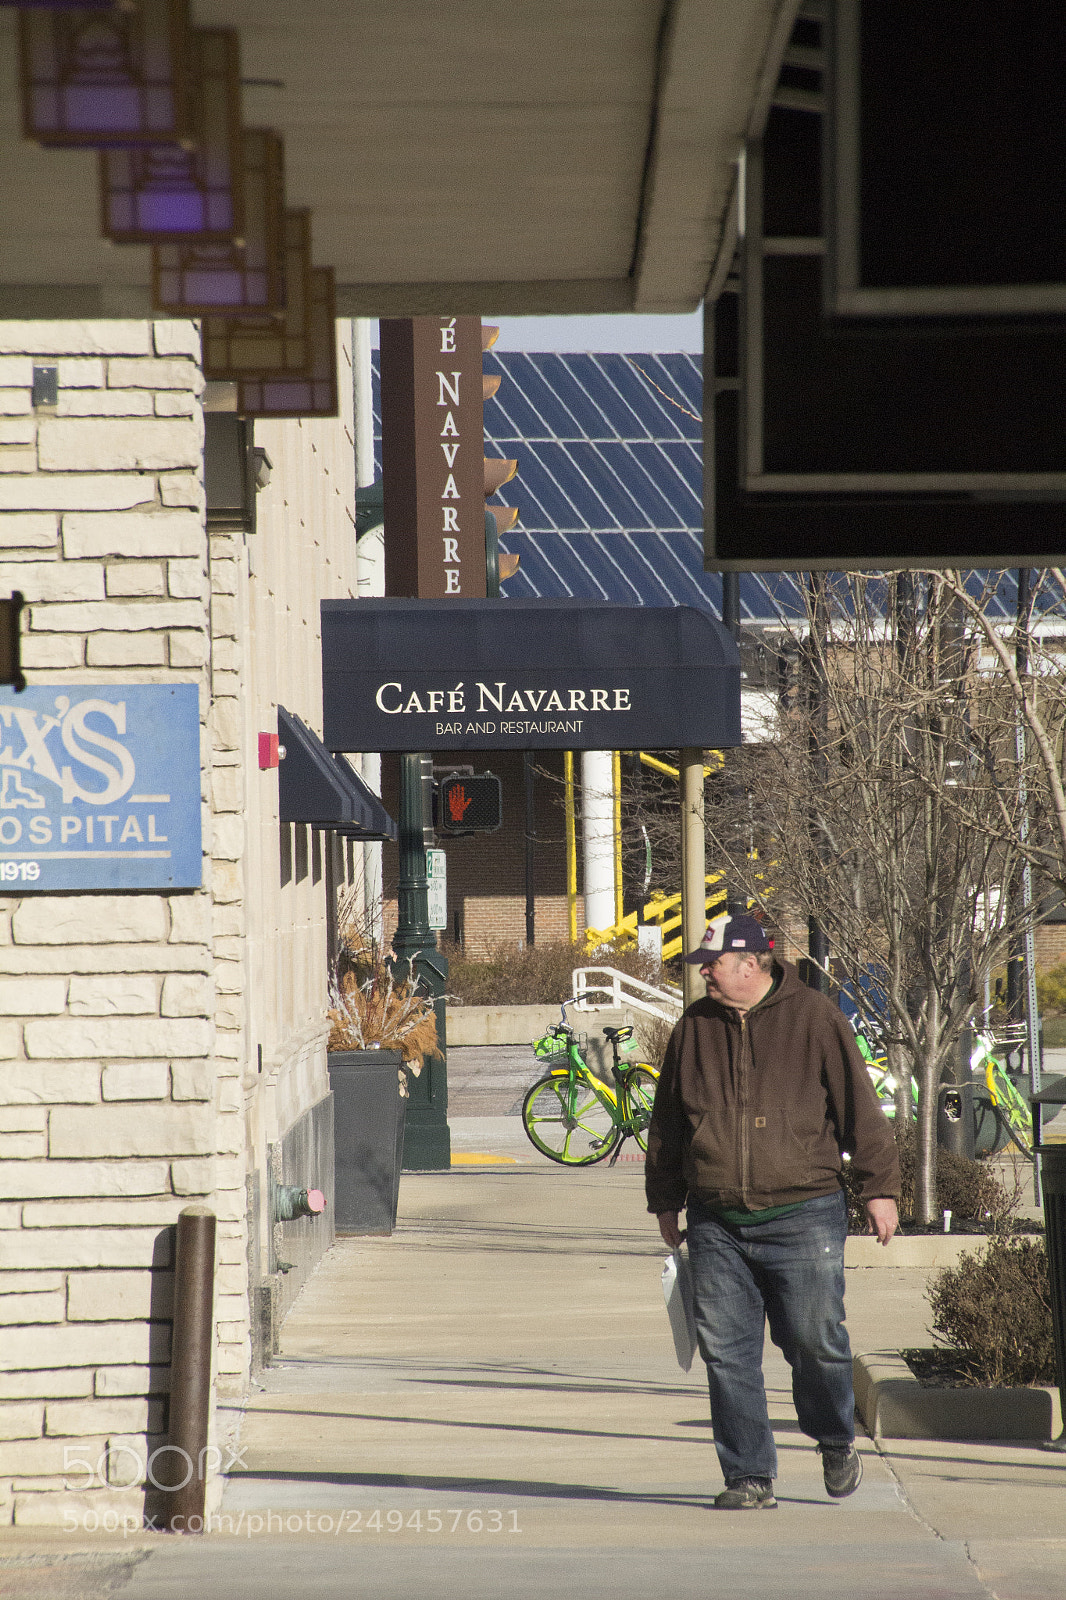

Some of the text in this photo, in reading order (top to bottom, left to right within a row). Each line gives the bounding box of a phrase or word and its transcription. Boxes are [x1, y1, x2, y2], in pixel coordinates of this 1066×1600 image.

[436, 371, 462, 594] NAVARRE
[435, 720, 583, 735] BAR AND RESTAURANT
